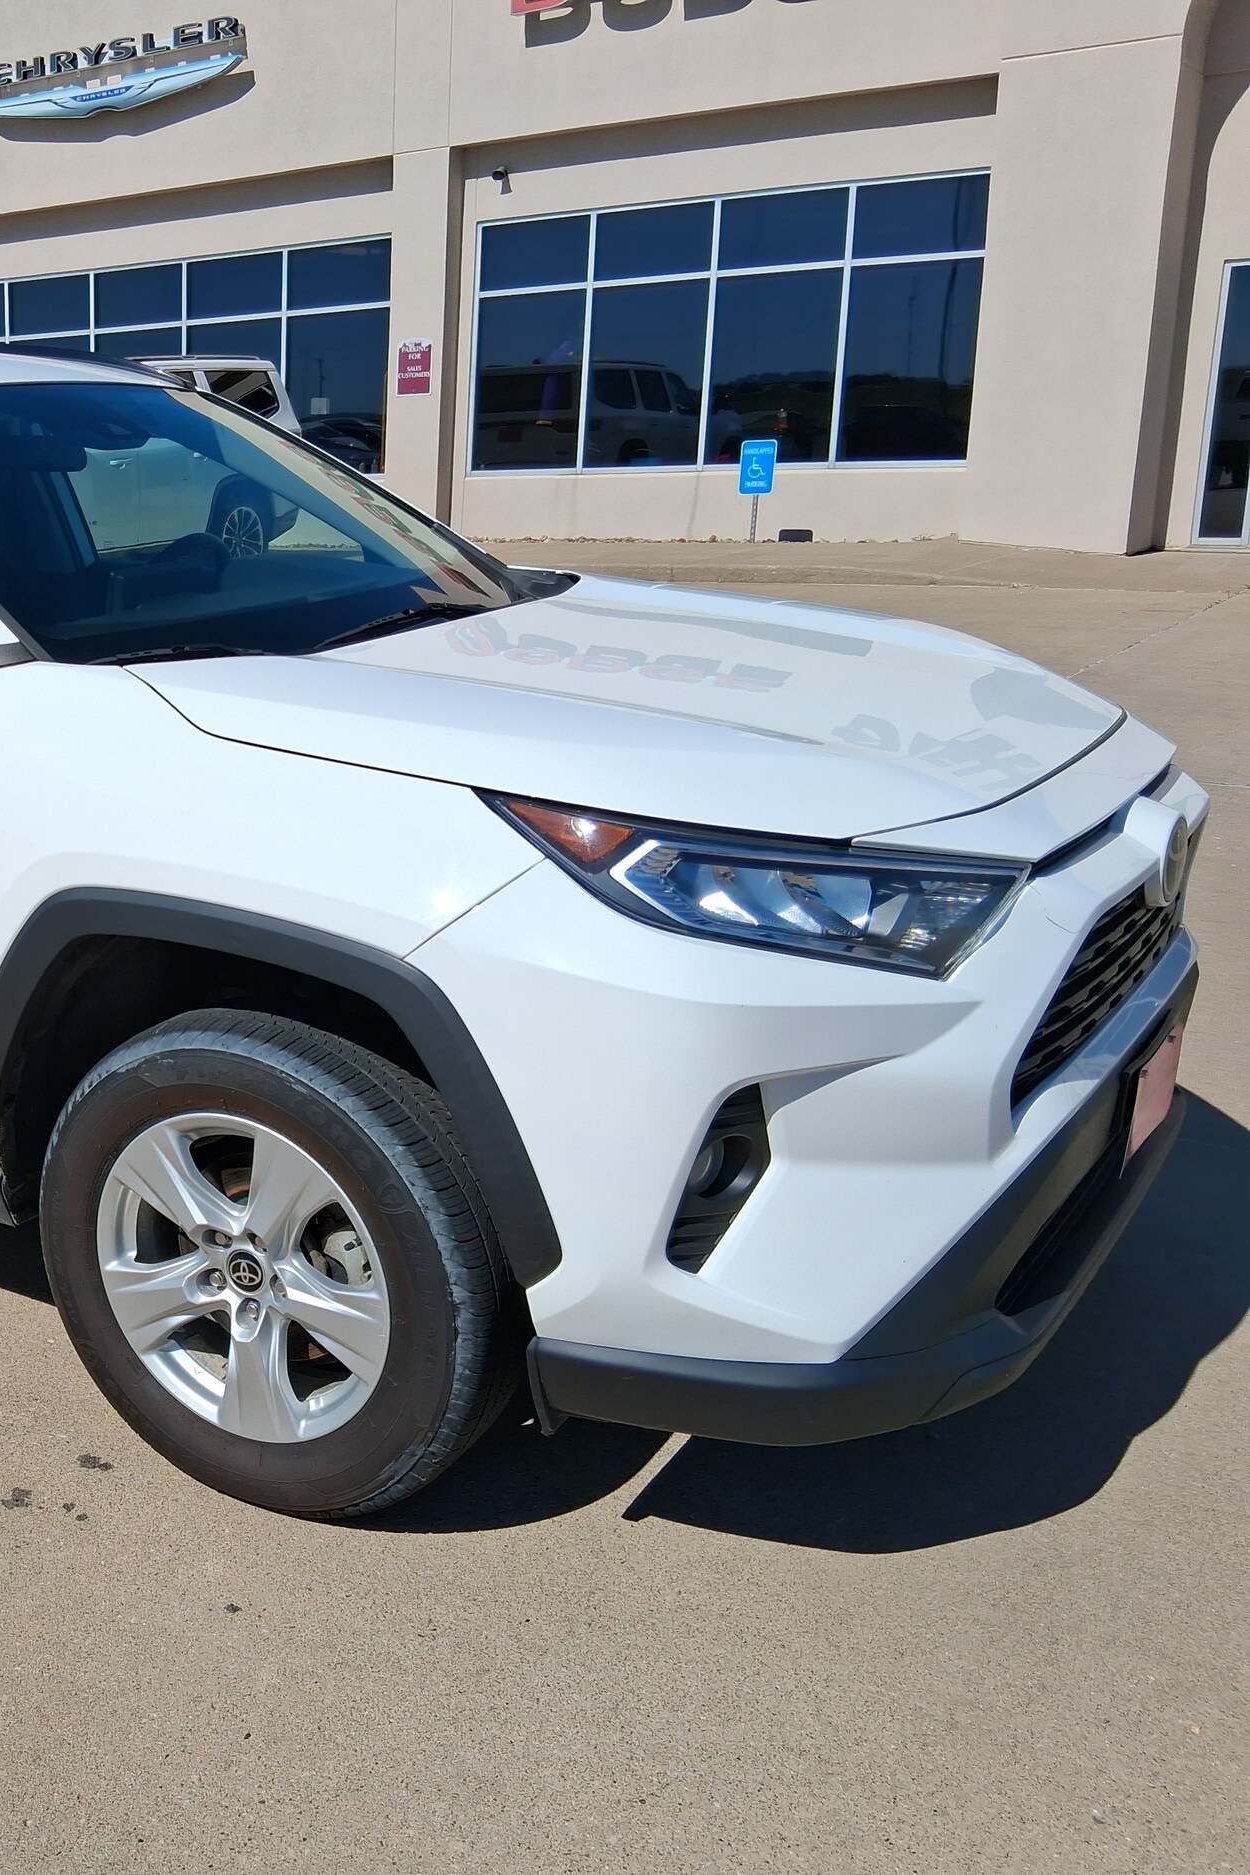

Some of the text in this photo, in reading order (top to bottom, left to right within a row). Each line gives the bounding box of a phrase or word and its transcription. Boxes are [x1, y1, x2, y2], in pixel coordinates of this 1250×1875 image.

[76, 88, 126, 101] CHRYSLER
[398, 371, 430, 379] CUSTOMERS
[743, 447, 774, 455] HANDICAPPED
[744, 480, 768, 488] PARKING
